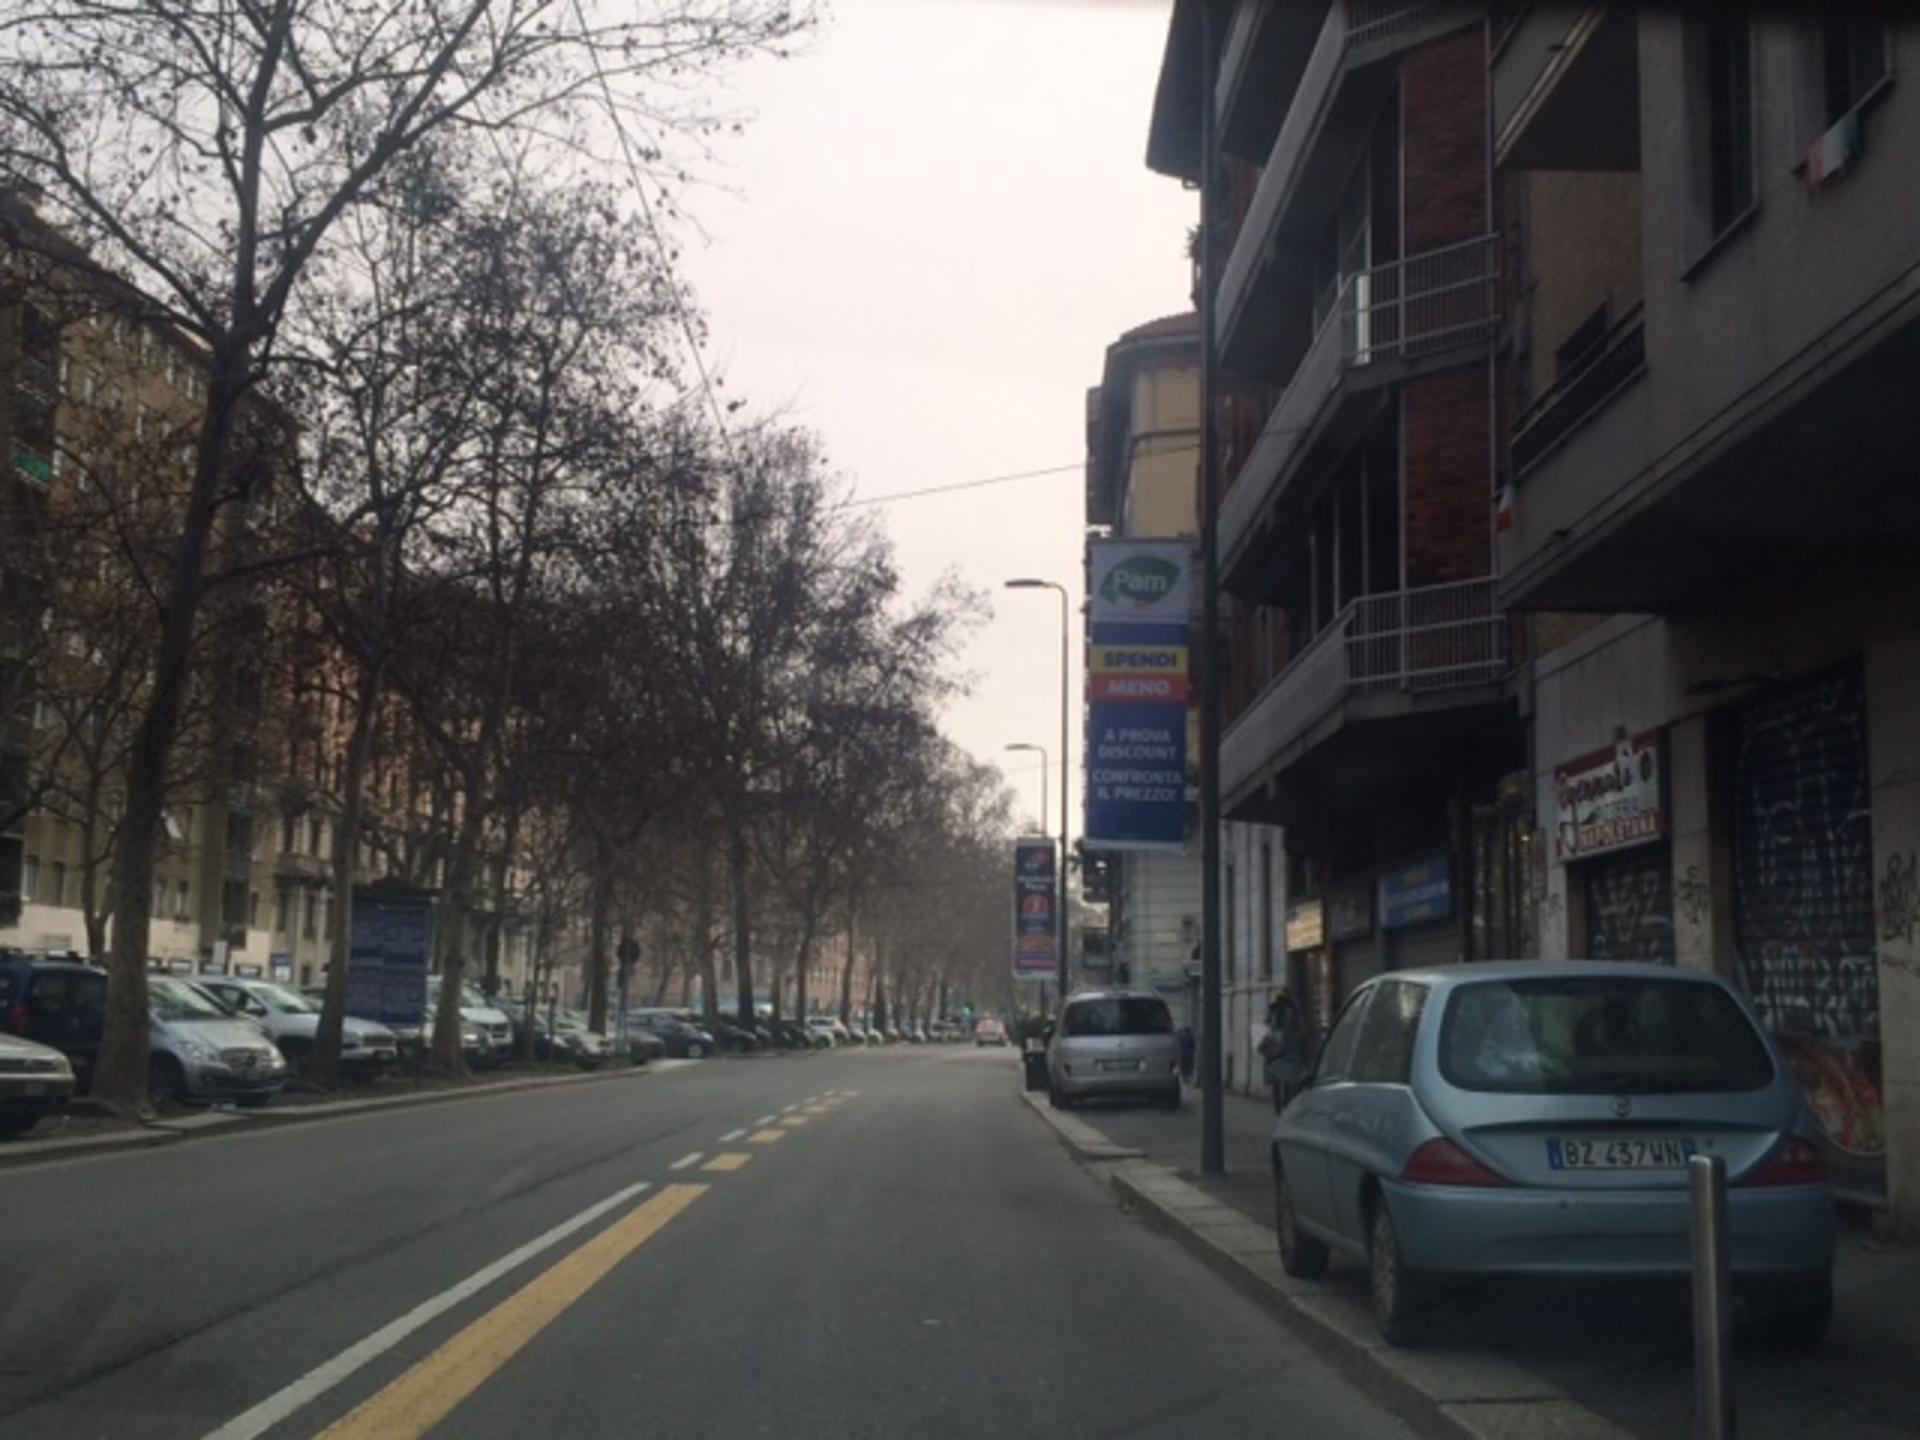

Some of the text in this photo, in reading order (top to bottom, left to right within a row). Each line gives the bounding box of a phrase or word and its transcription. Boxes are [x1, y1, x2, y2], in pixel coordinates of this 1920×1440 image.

[1112, 569, 1168, 592] Pam
[1103, 652, 1177, 668] SPENDI
[1107, 679, 1170, 695] MENO
[1104, 728, 1171, 743] A PROVA
[1097, 745, 1177, 760] DISCOUNT
[1091, 769, 1183, 785] CONFRONTA
[1565, 1141, 1595, 1165] BZ
